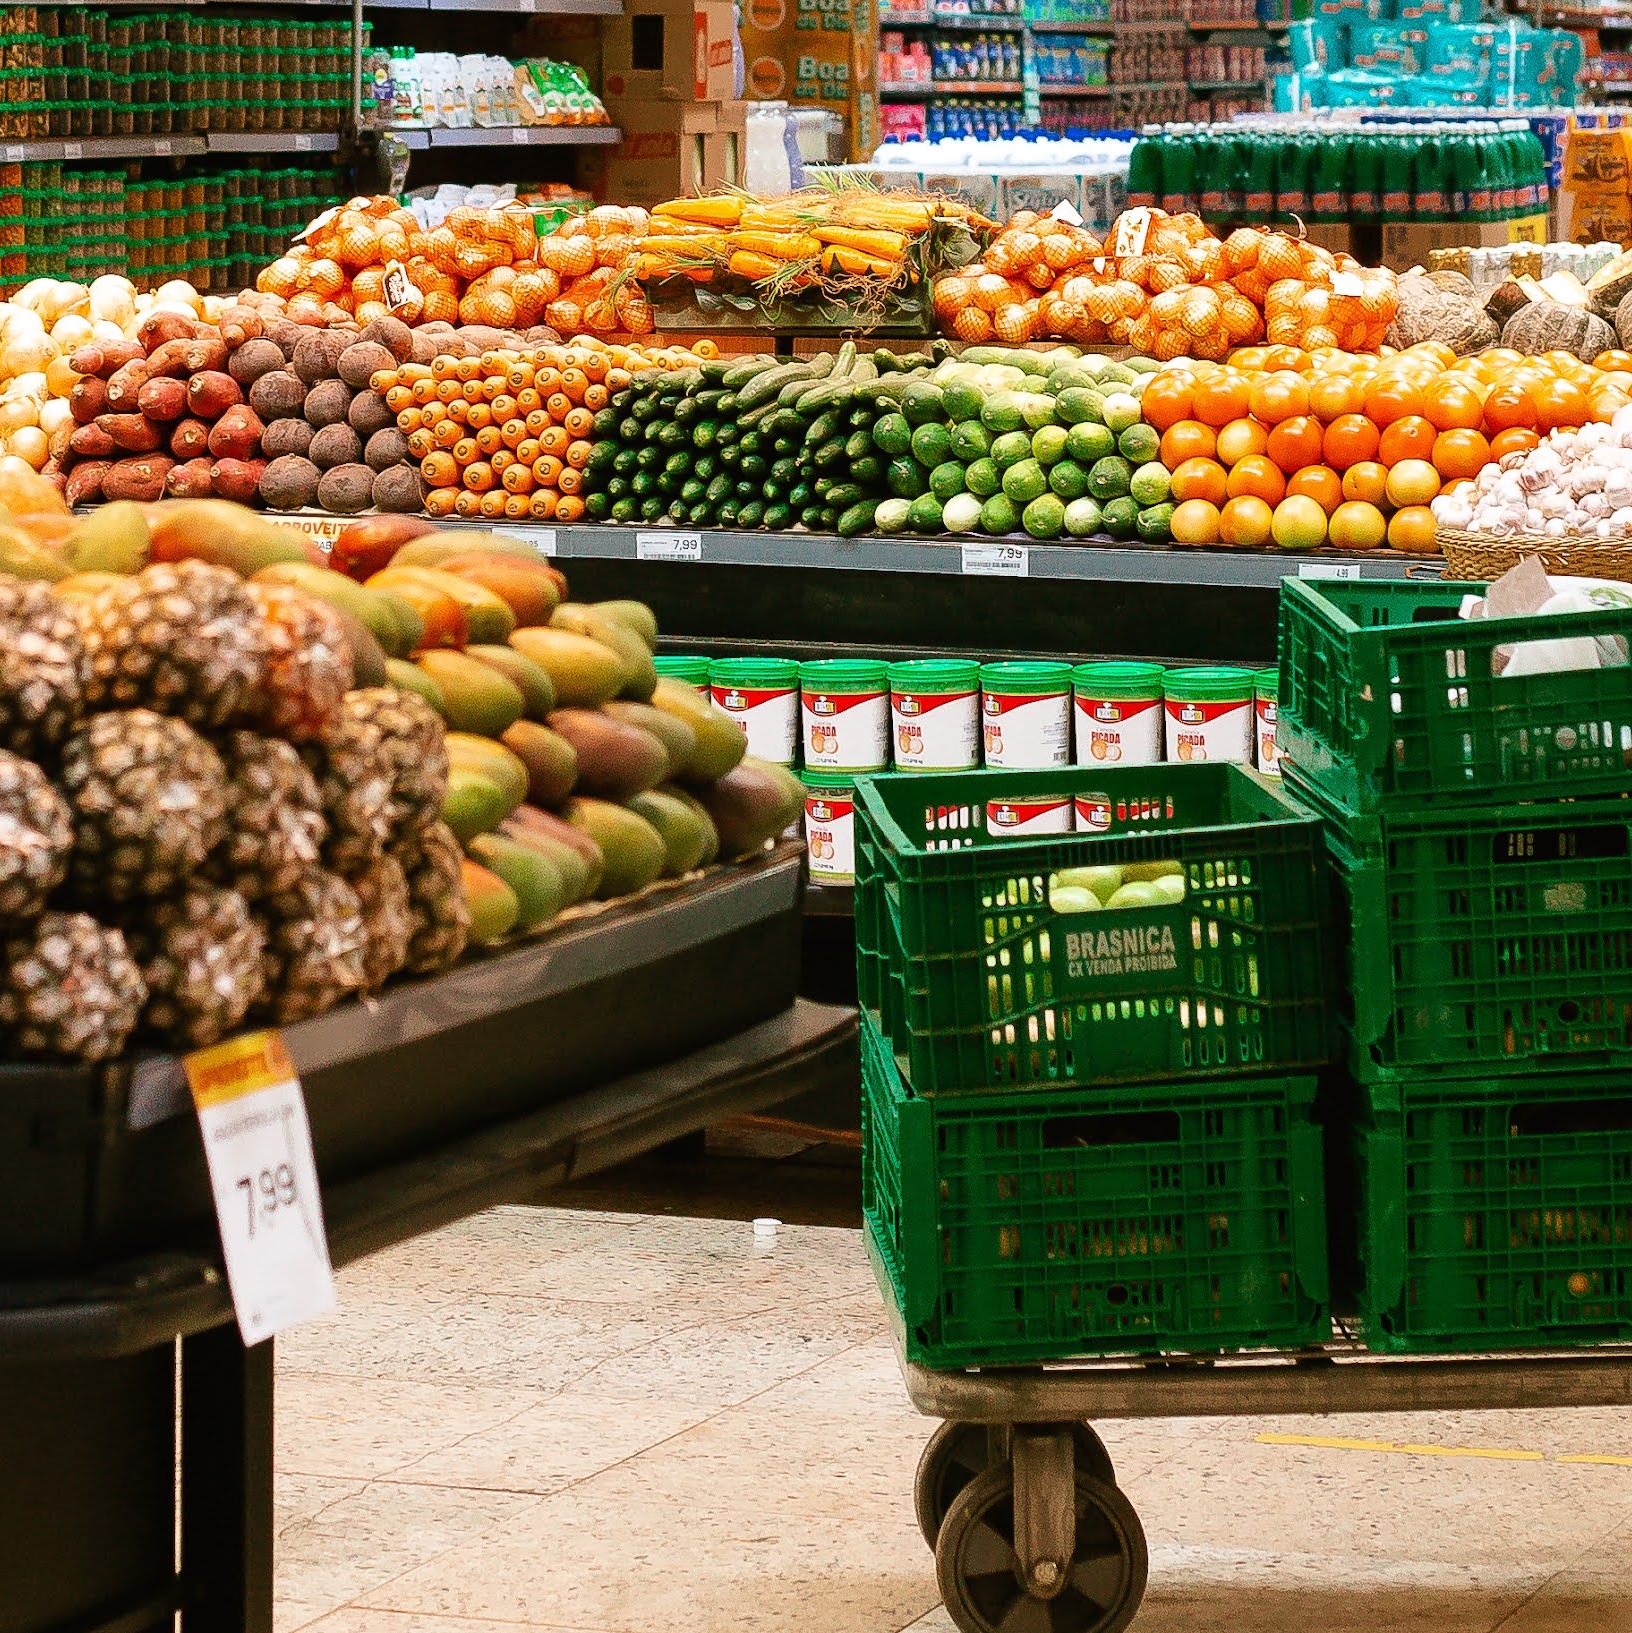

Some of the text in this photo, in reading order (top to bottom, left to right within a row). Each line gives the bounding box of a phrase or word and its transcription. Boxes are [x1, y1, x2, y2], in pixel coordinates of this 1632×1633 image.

[797, 55, 850, 81] Boa
[673, 539, 698, 551] 7,99
[997, 548, 1023, 560] 7,99
[1091, 731, 1121, 744] PICADA
[1177, 733, 1205, 746] PICADA
[1066, 925, 1175, 961] BRASNICA
[1125, 953, 1177, 972] PROIBIDA
